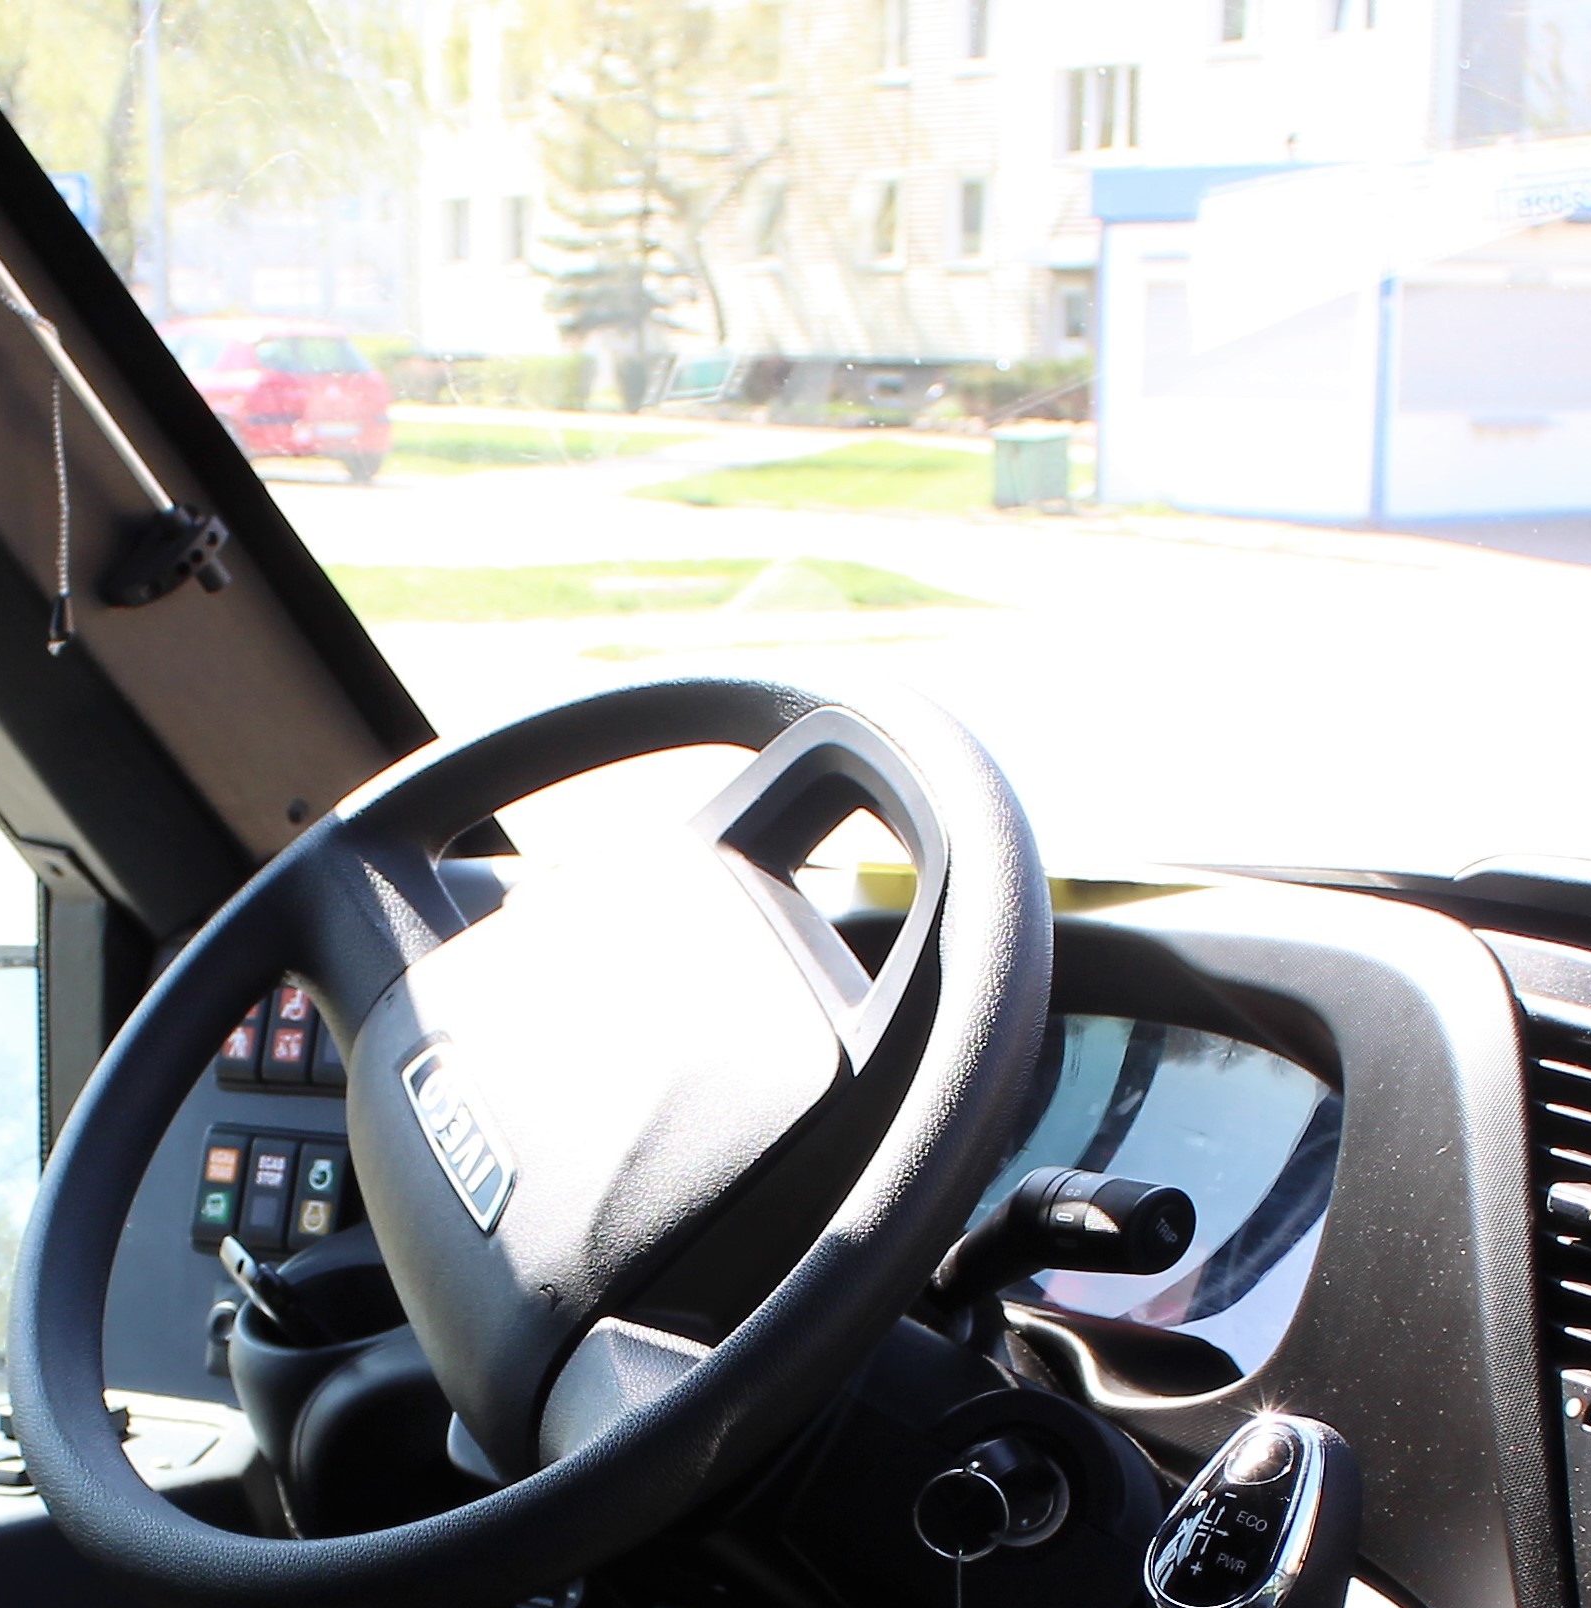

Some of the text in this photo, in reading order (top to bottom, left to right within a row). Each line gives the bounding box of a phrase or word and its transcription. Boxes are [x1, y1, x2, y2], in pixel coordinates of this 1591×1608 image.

[418, 1066, 495, 1193] IVECO
[1155, 1217, 1178, 1243] TRIP
[1192, 1490, 1209, 1506] R
[1235, 1510, 1268, 1532] ECO
[1216, 1552, 1248, 1575] PWR
